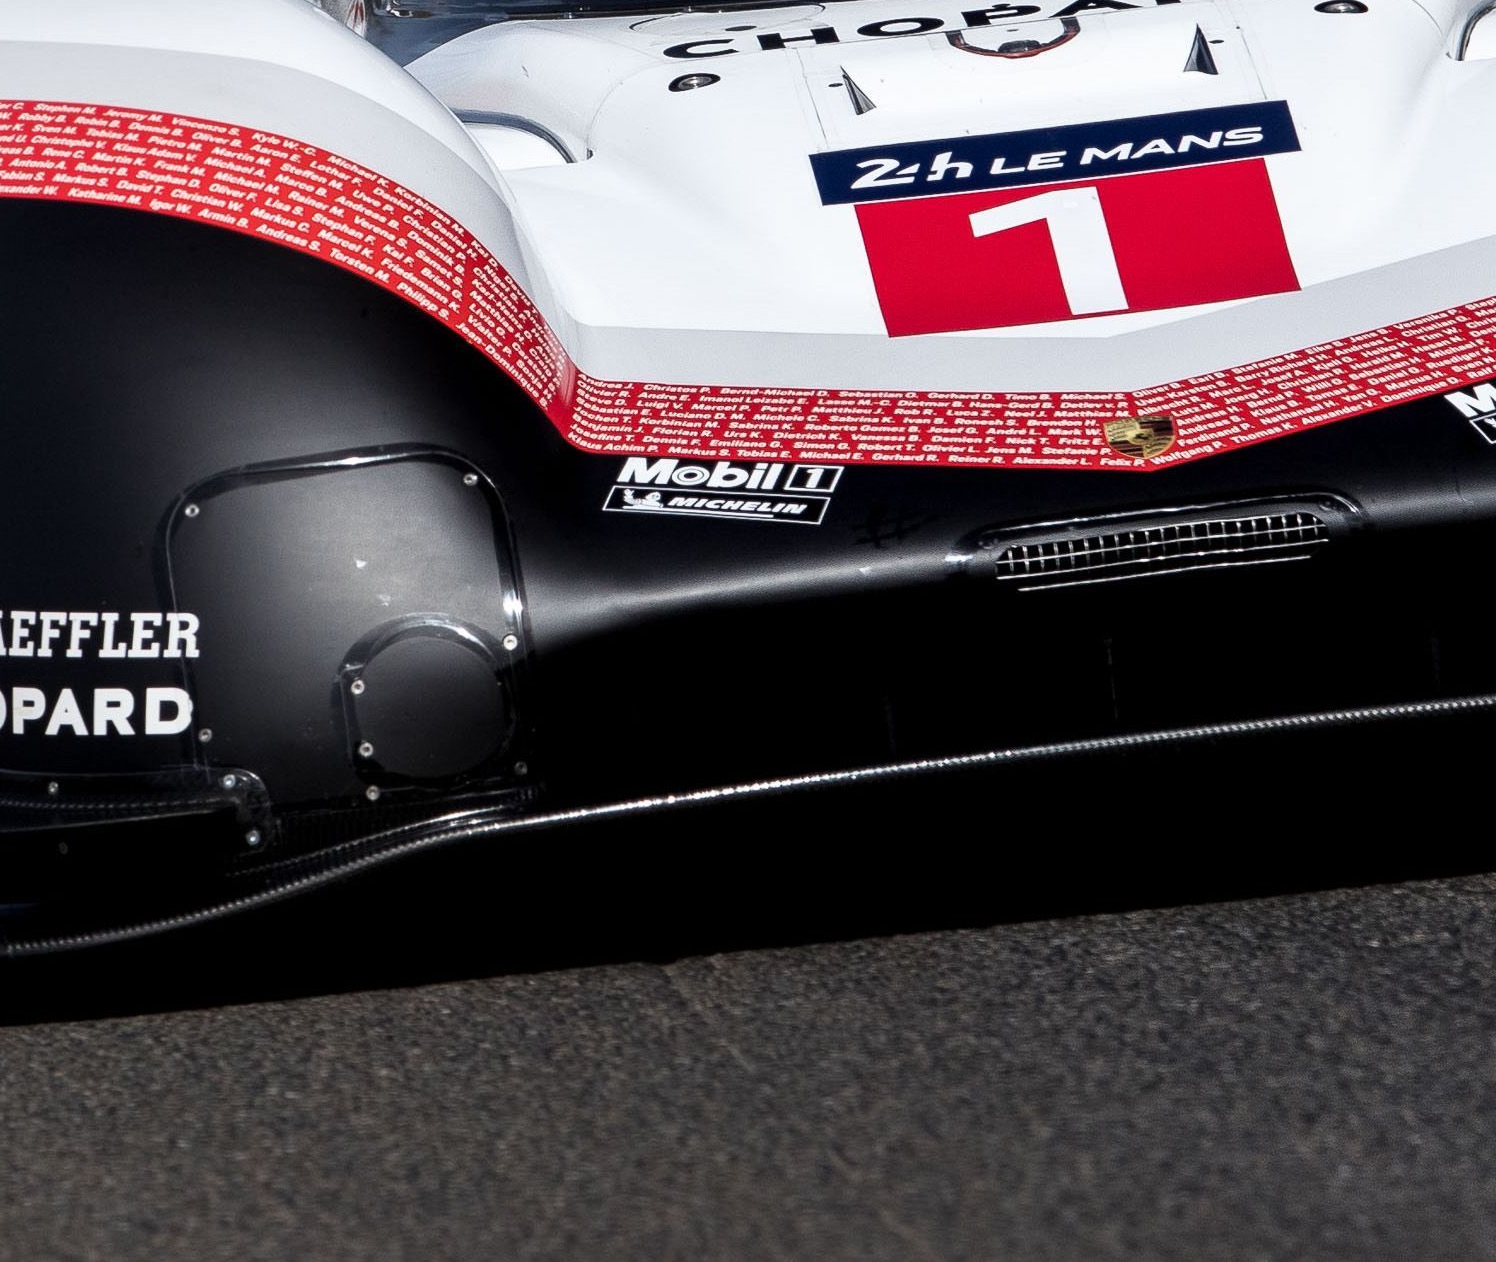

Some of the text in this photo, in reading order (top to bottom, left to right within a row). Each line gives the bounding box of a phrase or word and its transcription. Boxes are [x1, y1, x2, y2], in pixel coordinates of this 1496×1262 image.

[850, 126, 1265, 190] 24h LE MANS
[968, 186, 1130, 316] 1
[616, 457, 784, 489] Mobil
[667, 496, 808, 515] MICHELIN
